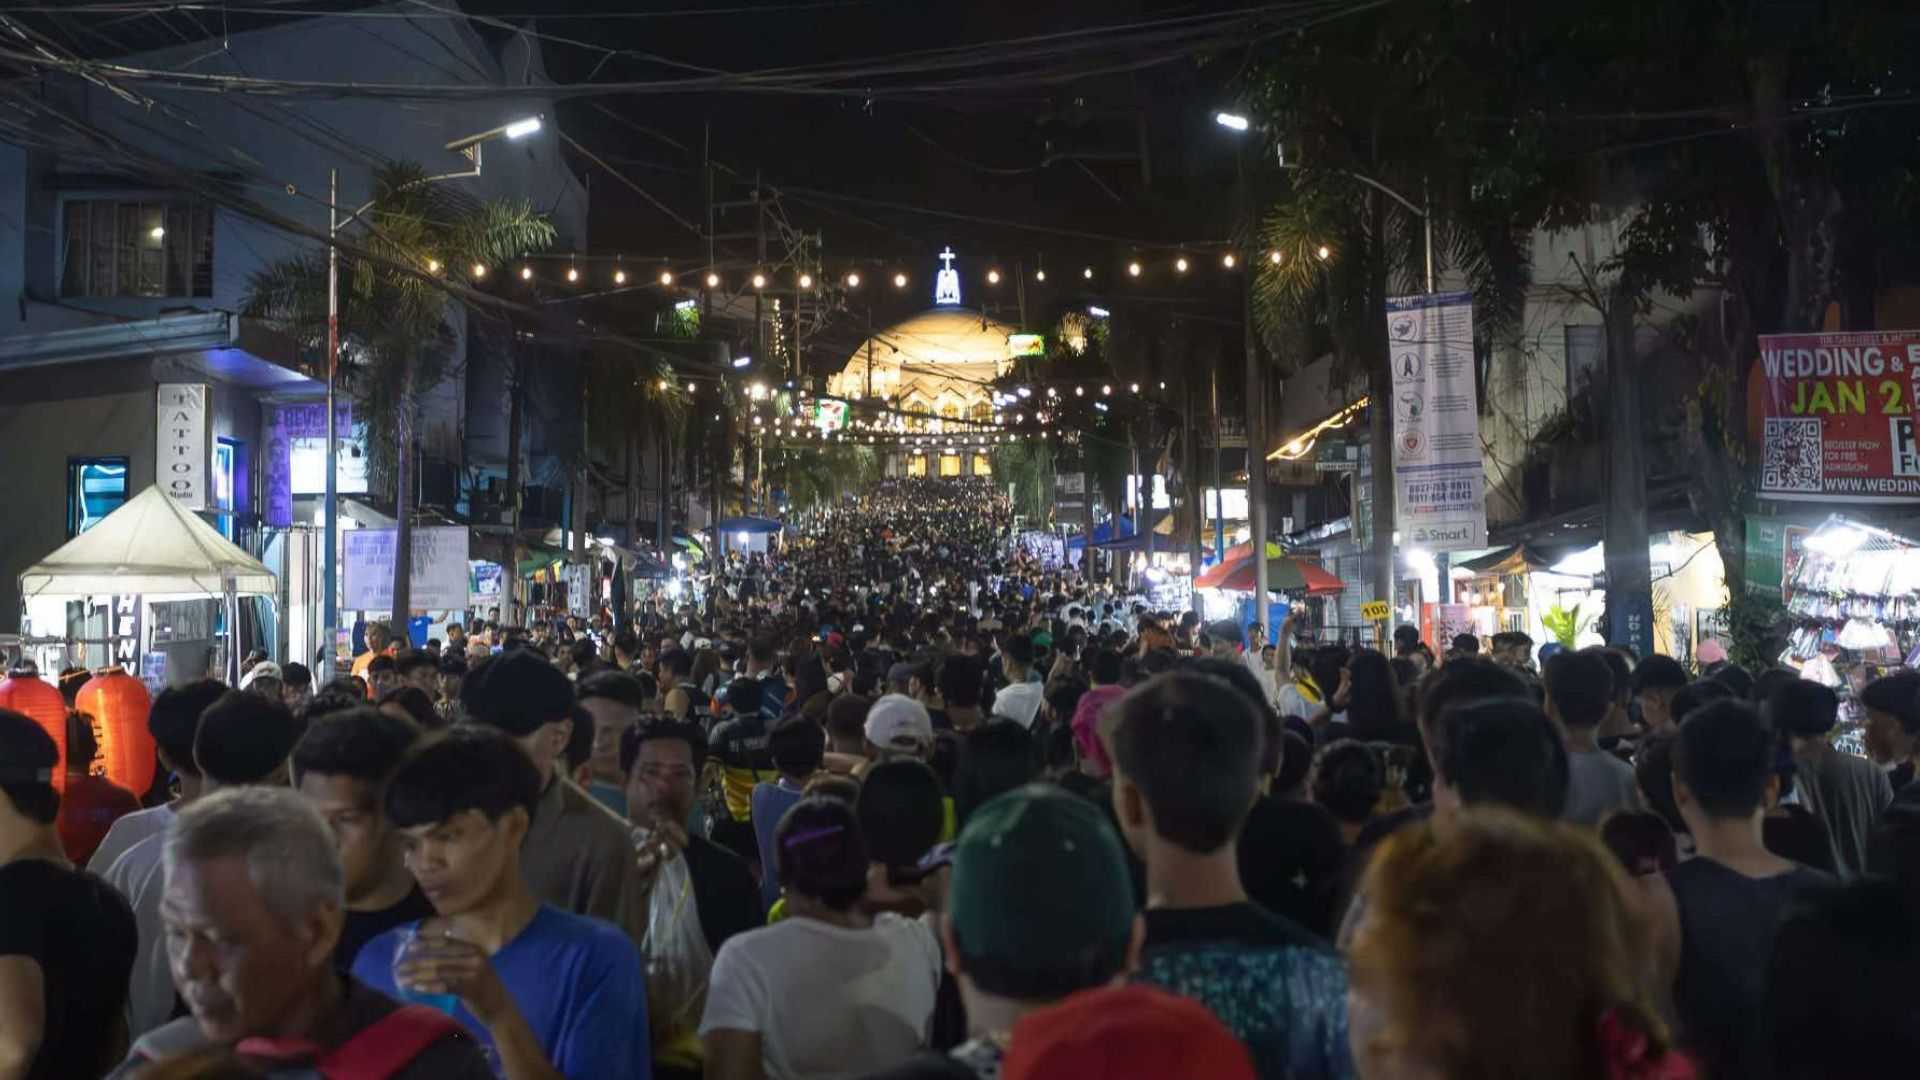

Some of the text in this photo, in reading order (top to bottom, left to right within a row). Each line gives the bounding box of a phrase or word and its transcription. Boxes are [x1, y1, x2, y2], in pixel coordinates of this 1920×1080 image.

[1760, 347, 1885, 379] WEDDING
[1891, 355, 1905, 373] &
[1791, 381, 1866, 416] JAN
[171, 393, 191, 489] TATTOO
[1430, 527, 1469, 541] Smart
[1363, 605, 1389, 617] 100
